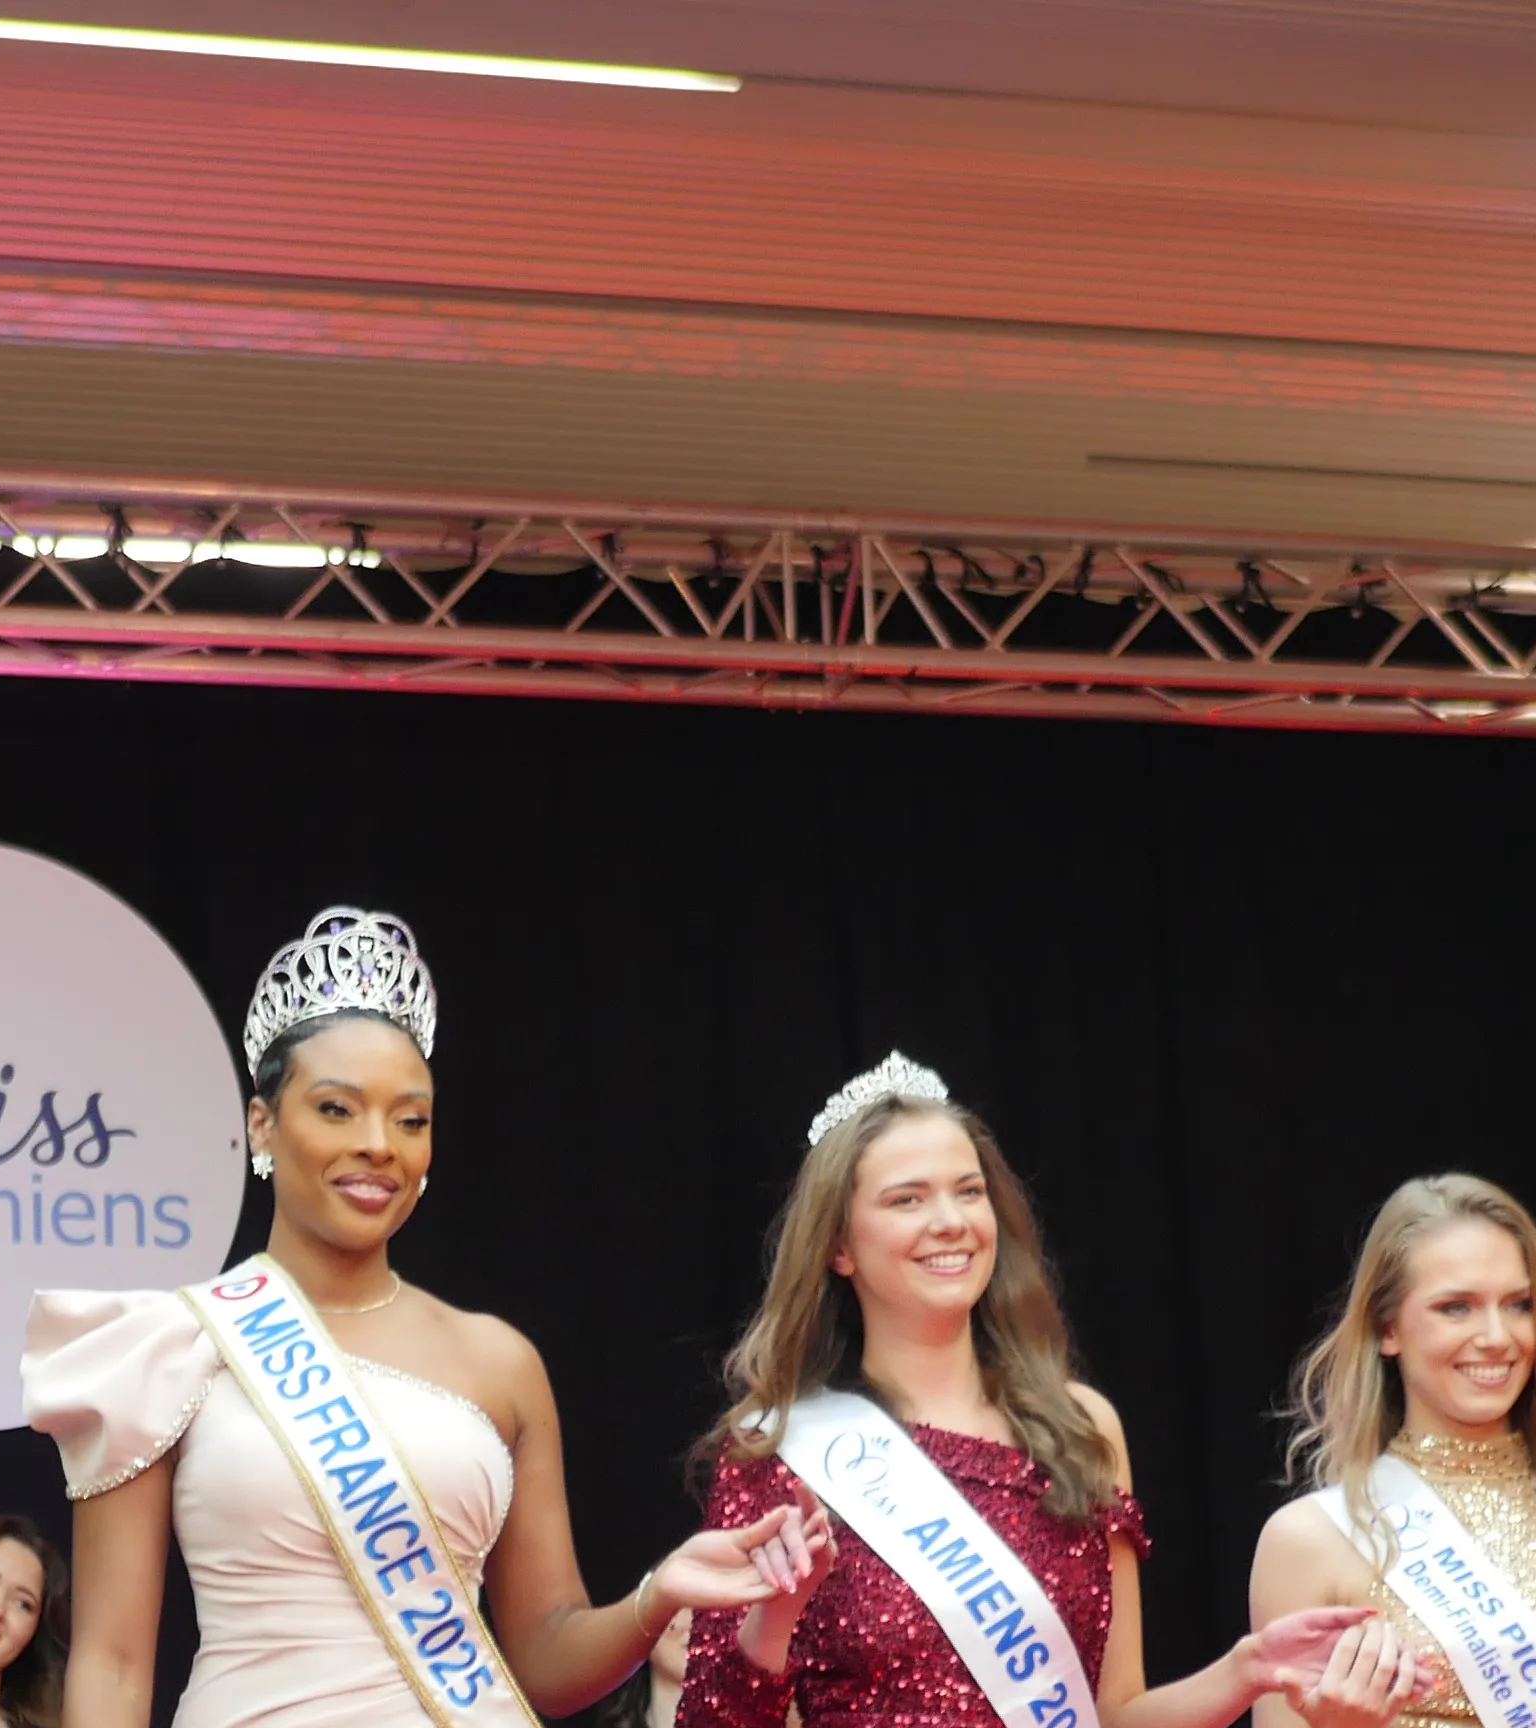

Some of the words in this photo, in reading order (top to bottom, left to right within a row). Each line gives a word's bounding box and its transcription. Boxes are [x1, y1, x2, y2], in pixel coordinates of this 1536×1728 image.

[233, 1297, 331, 1401] MISS
[293, 1395, 436, 1597] FRANCE
[399, 1588, 495, 1708] 2025
[903, 1516, 1049, 1683] AMIENS
[1402, 1559, 1512, 1702] Demi-Finaliste
[1432, 1546, 1504, 1616] MISS
